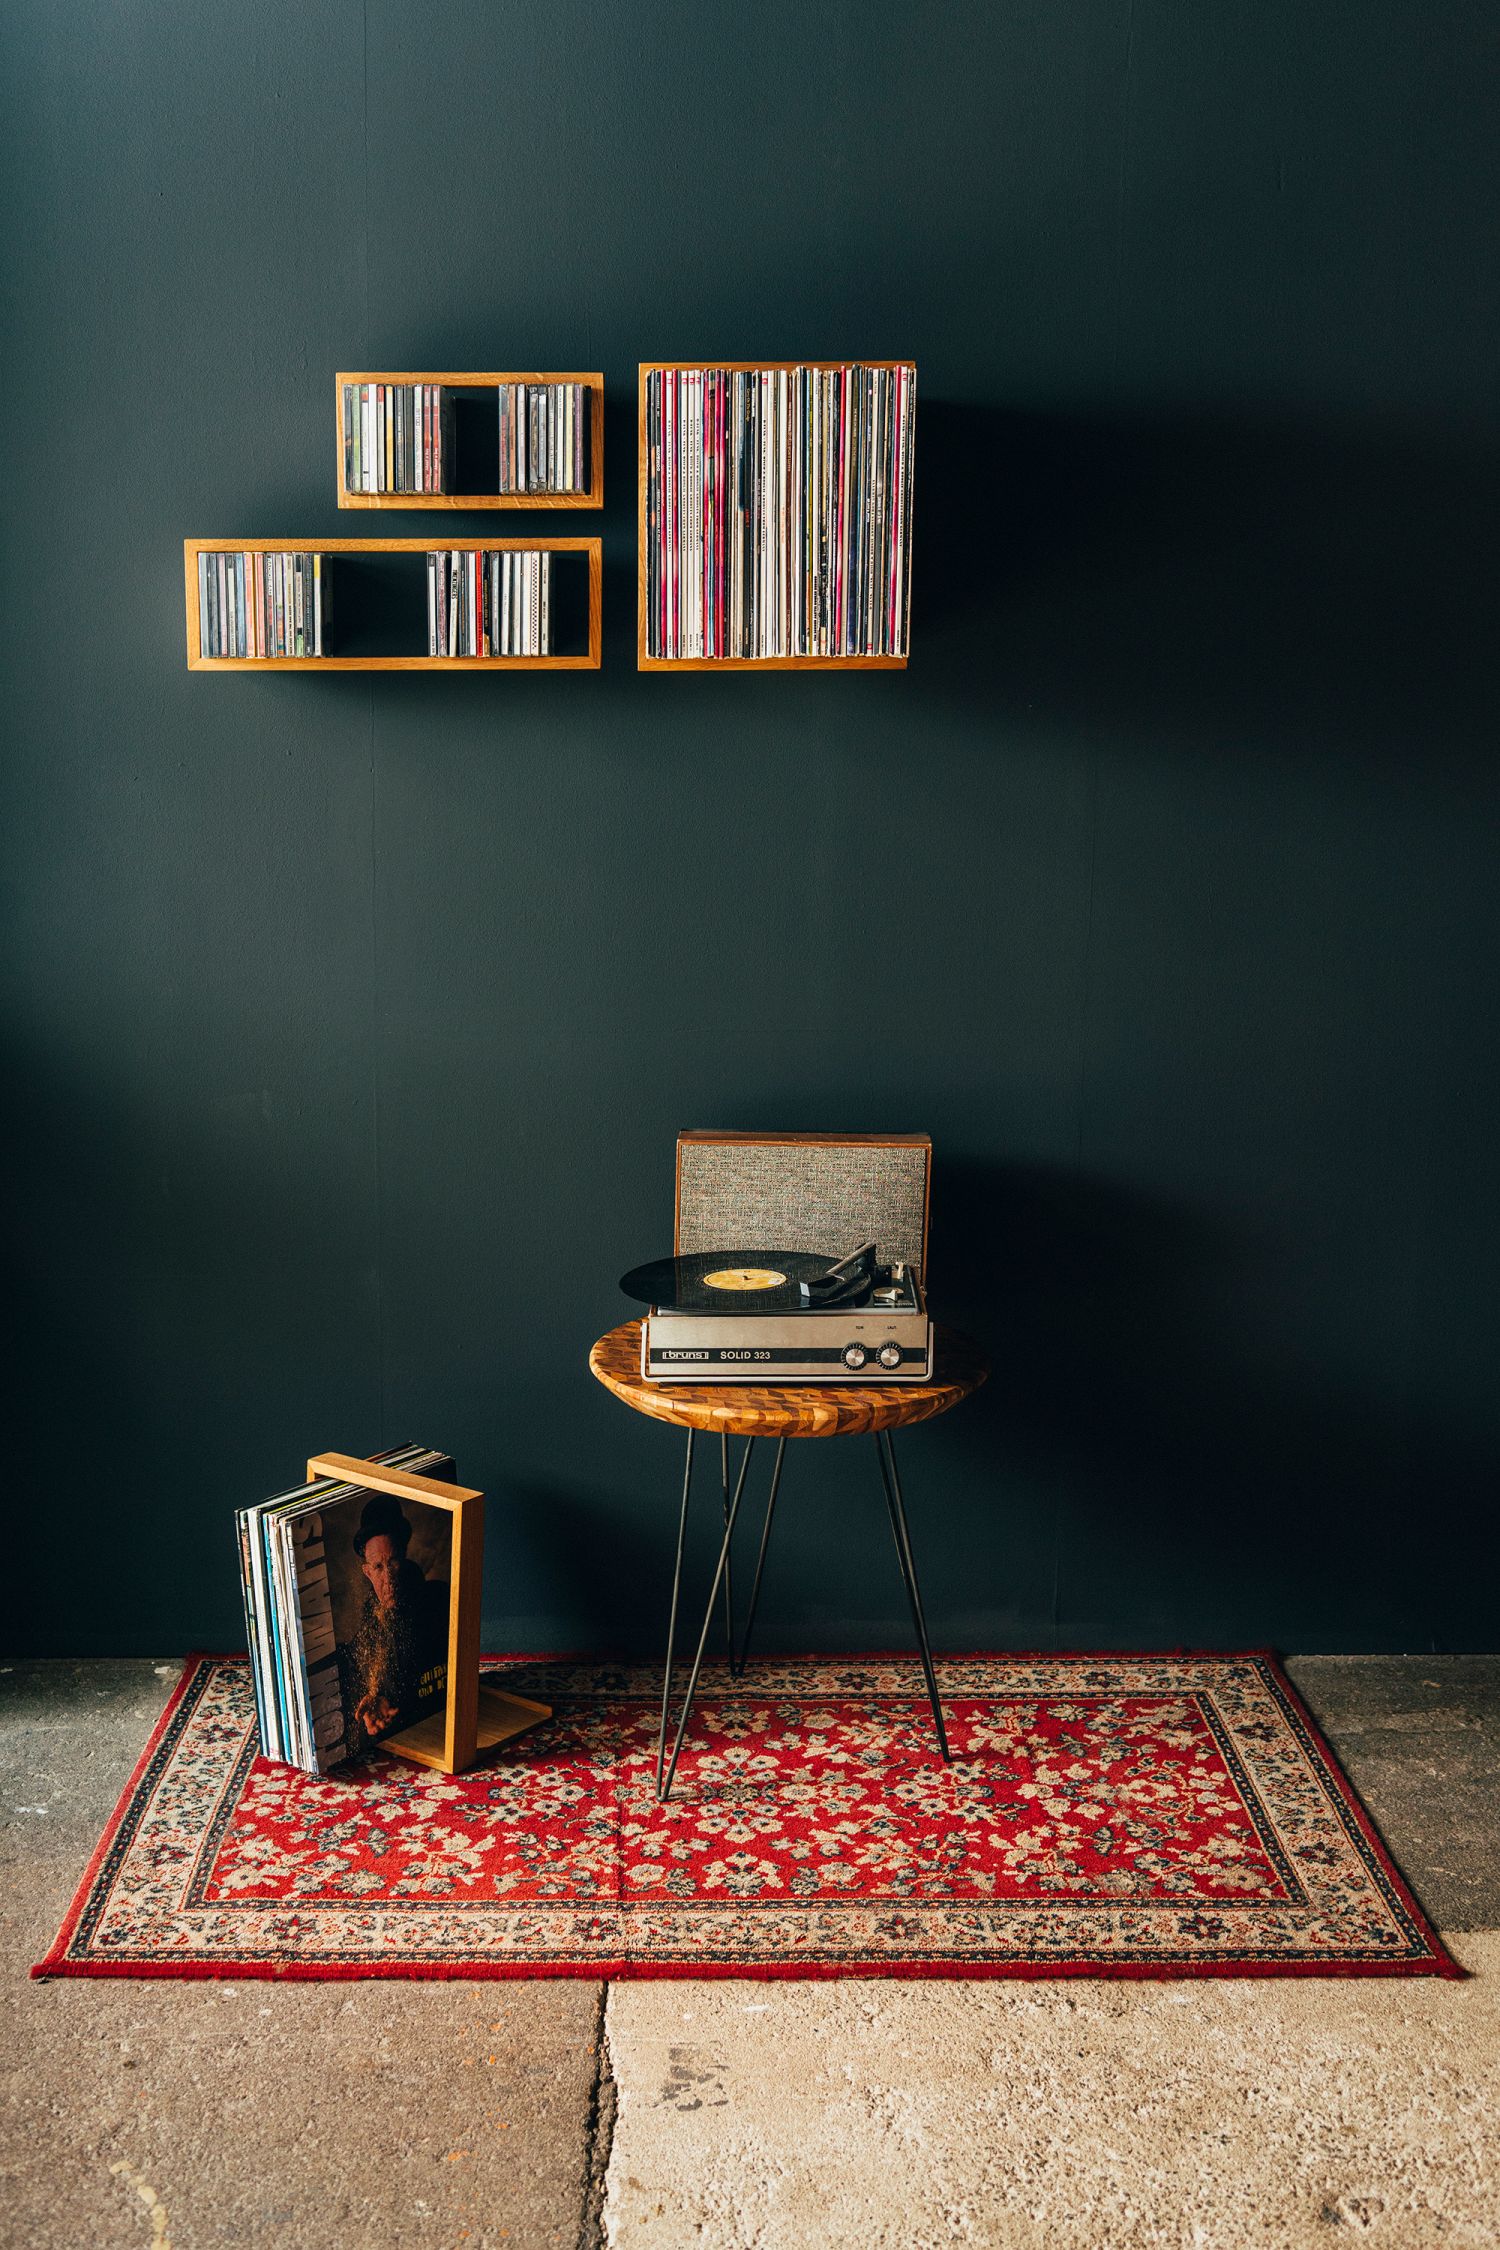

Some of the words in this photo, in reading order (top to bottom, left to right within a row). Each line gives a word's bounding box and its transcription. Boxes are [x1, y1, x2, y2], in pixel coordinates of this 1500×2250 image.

[666, 1350, 704, 1360] bruns
[720, 1351, 751, 1360] SOLID
[754, 1351, 771, 1360] 323
[292, 1512, 336, 1667] WAITS
[307, 1664, 347, 1773] TOM
